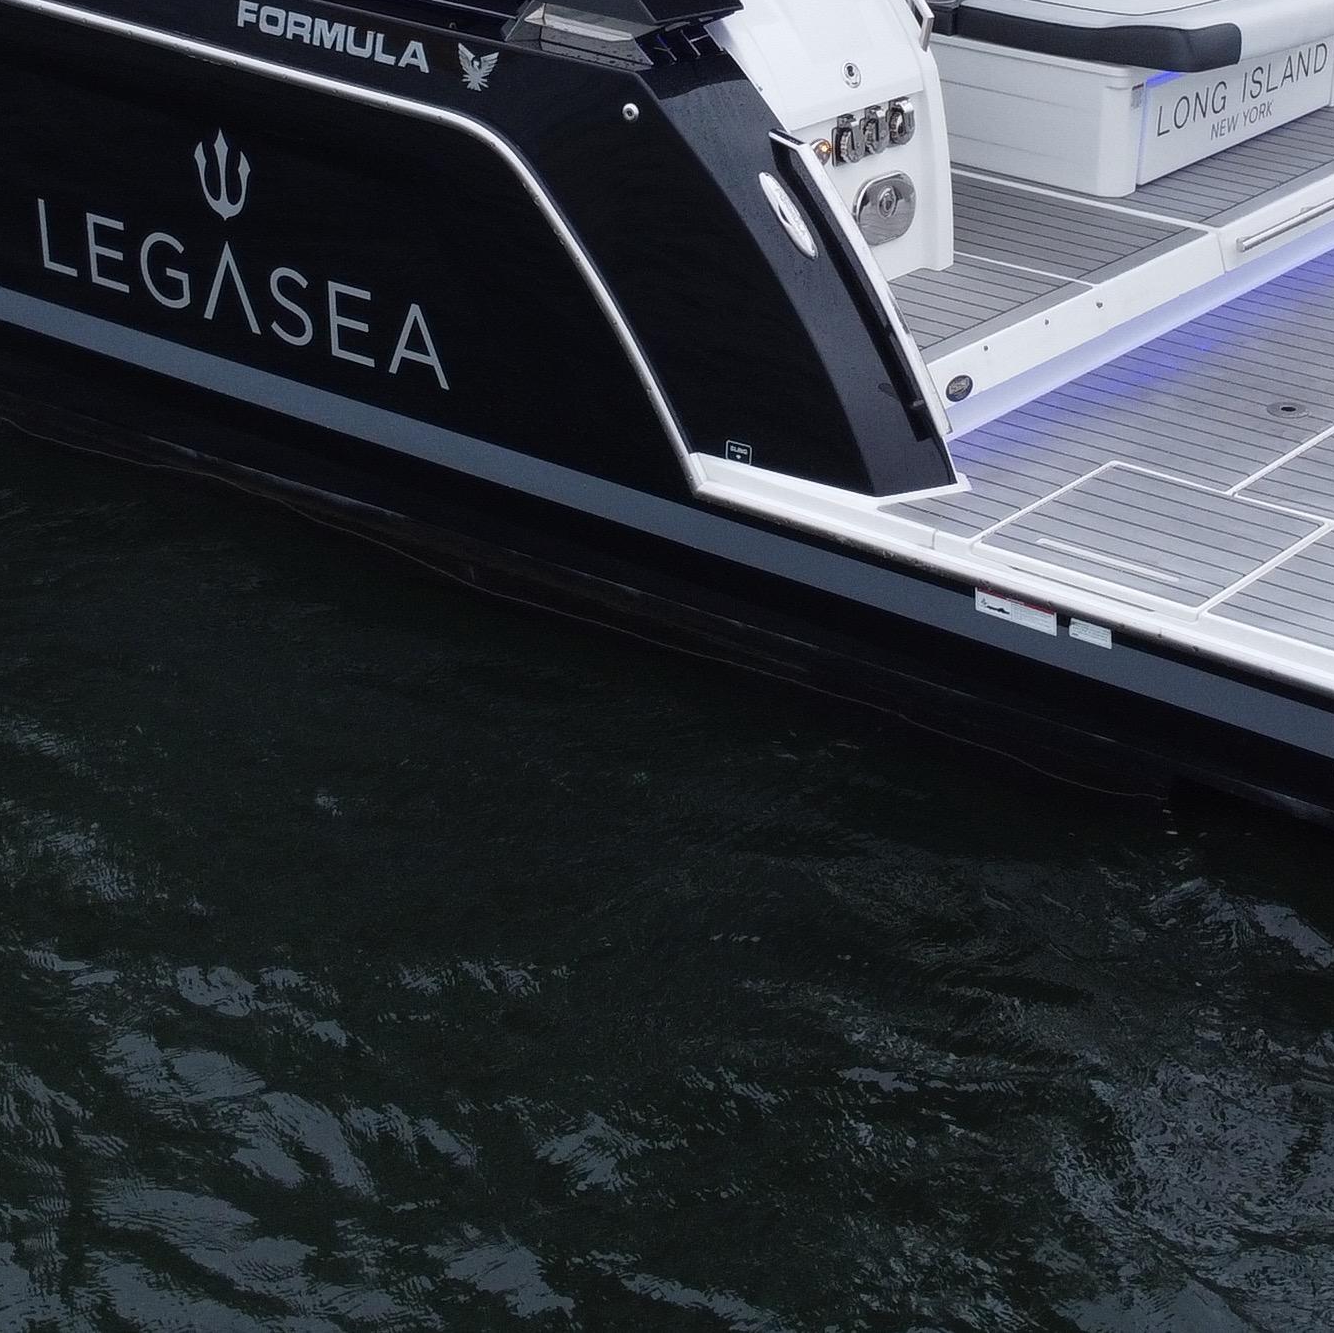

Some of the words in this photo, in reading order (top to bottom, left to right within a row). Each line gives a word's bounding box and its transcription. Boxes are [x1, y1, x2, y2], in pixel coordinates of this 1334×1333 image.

[237, 0, 430, 74] FORMULA
[1157, 81, 1227, 137] LONG
[1242, 42, 1328, 103] ISLAND
[1210, 118, 1239, 141] NEW
[1242, 100, 1275, 126] YORK
[37, 198, 451, 391] LEGASEA
